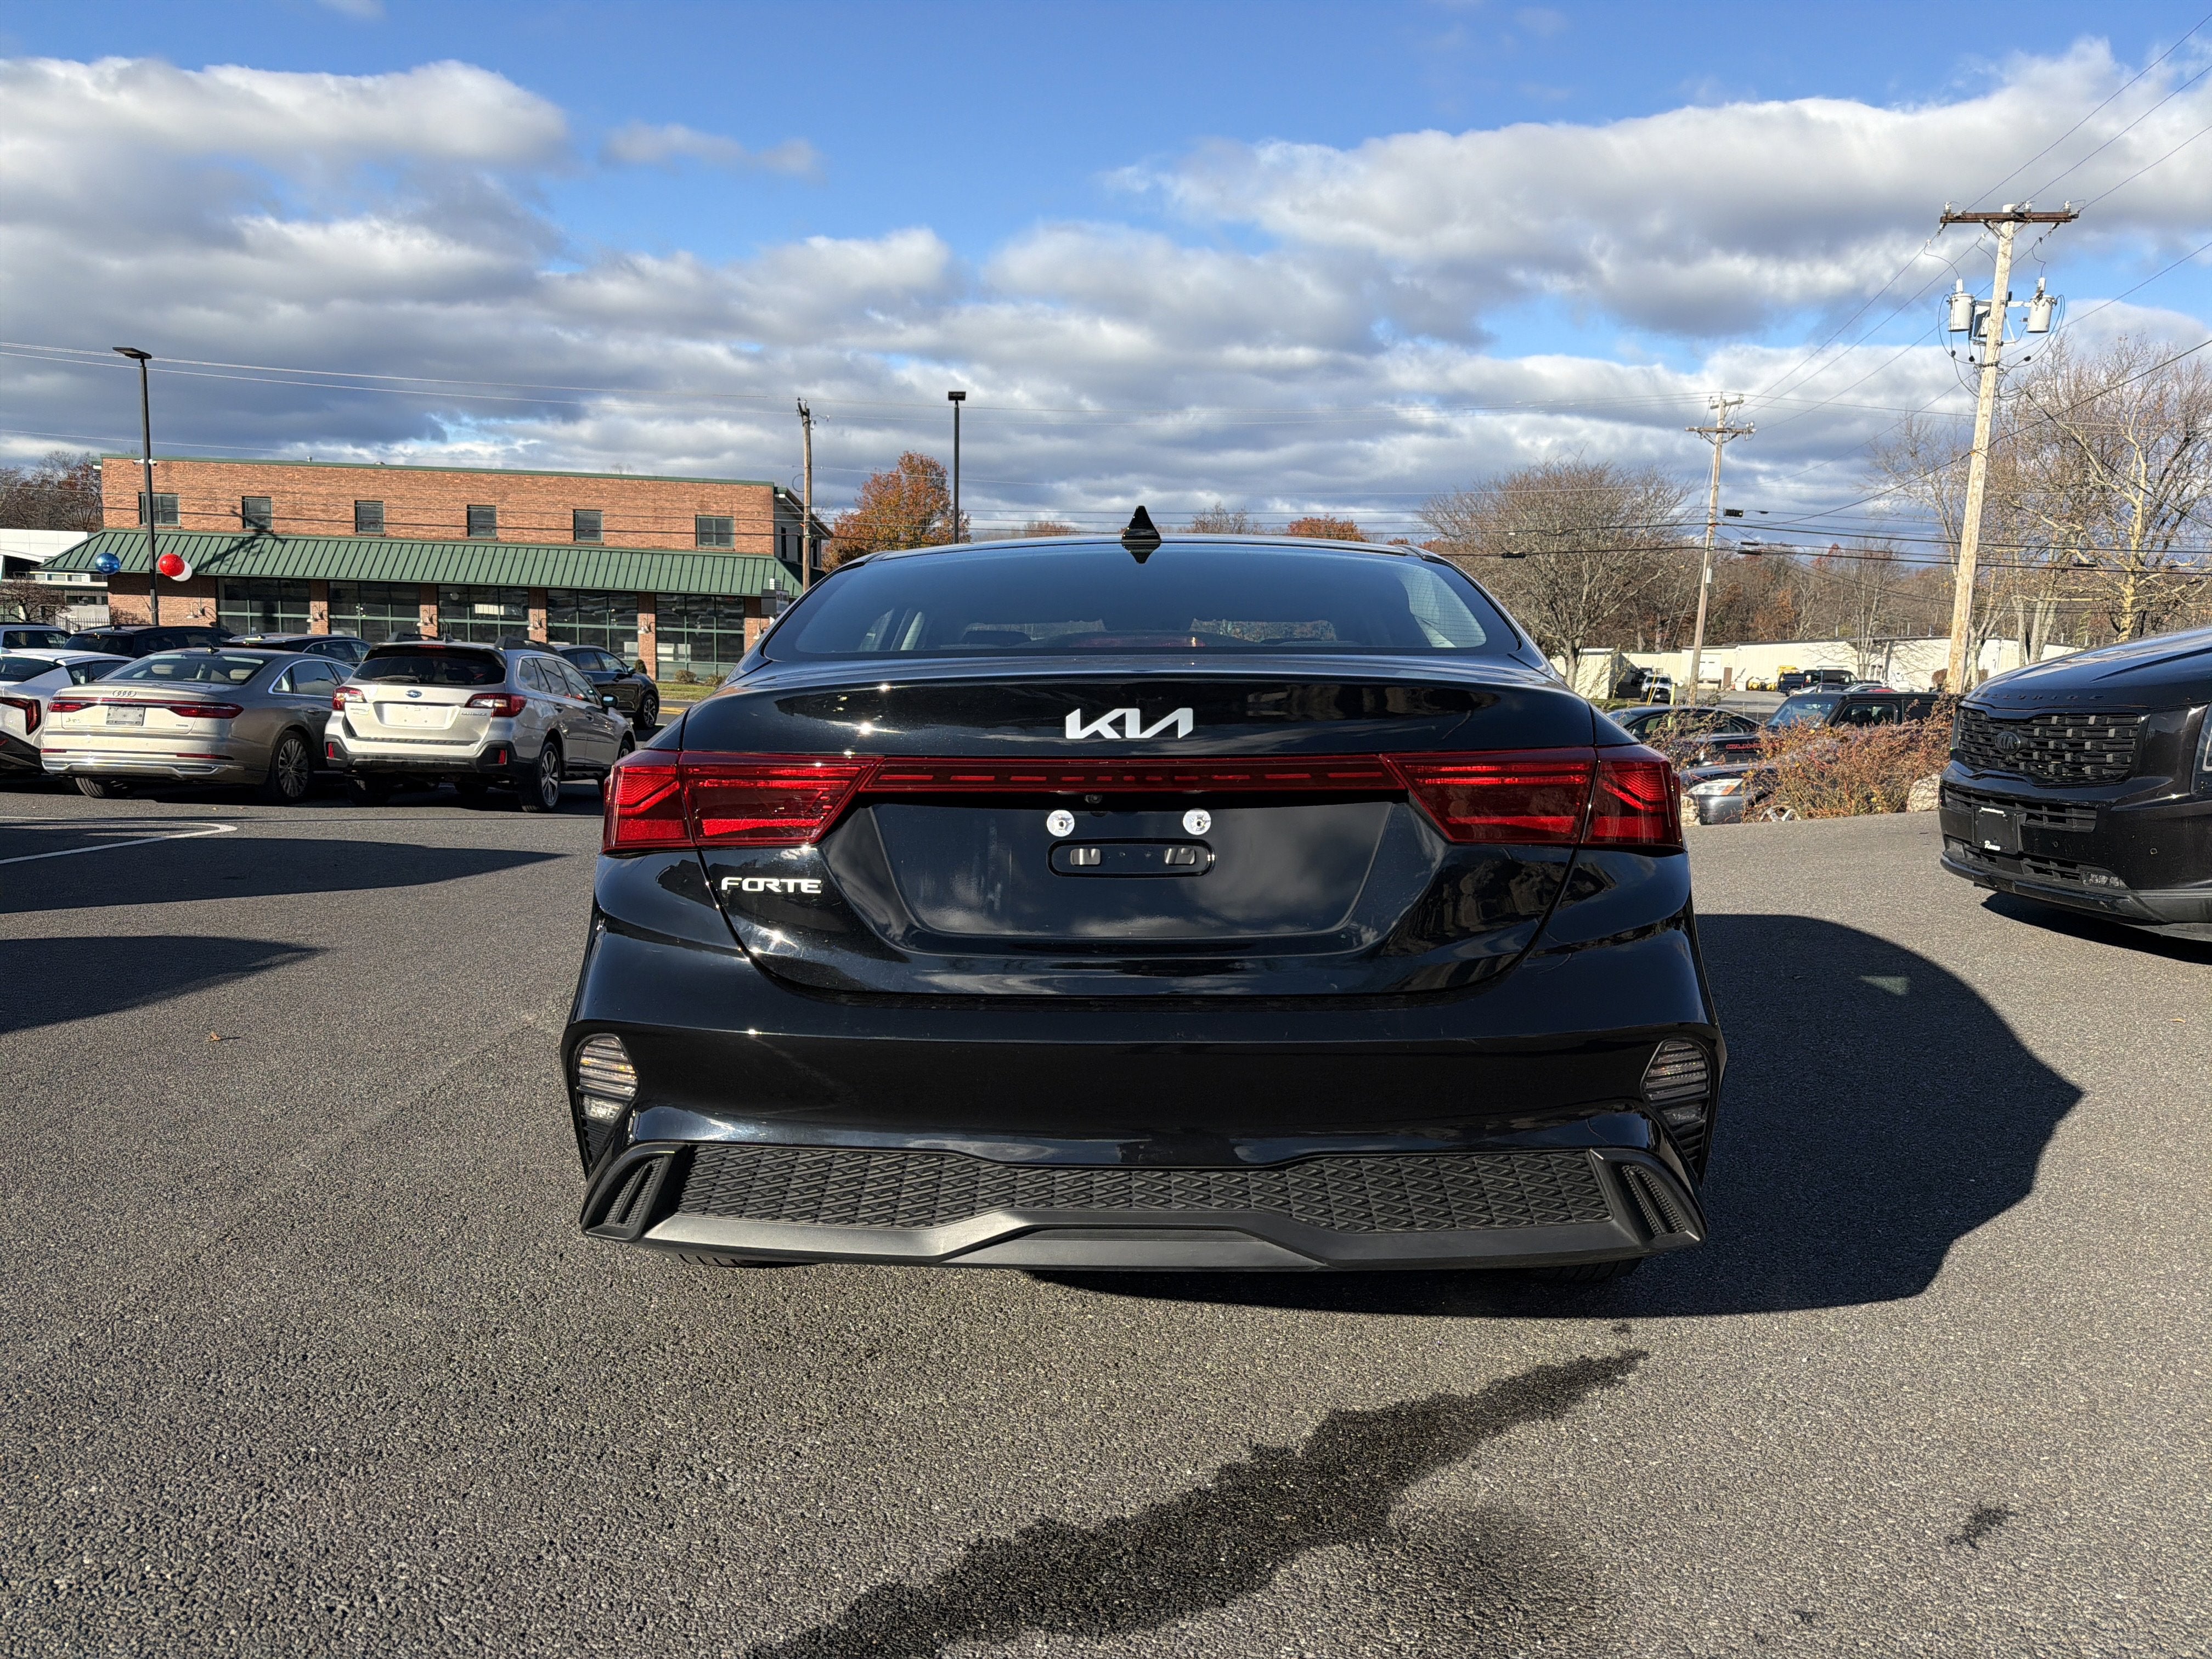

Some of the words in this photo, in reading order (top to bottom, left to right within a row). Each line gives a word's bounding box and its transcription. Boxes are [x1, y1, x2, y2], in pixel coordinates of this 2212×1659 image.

[1973, 692, 2105, 701] TELLURIDE
[1065, 707, 1194, 740] KIA
[1996, 735, 2015, 749] KIA
[721, 877, 822, 894] FORTE
